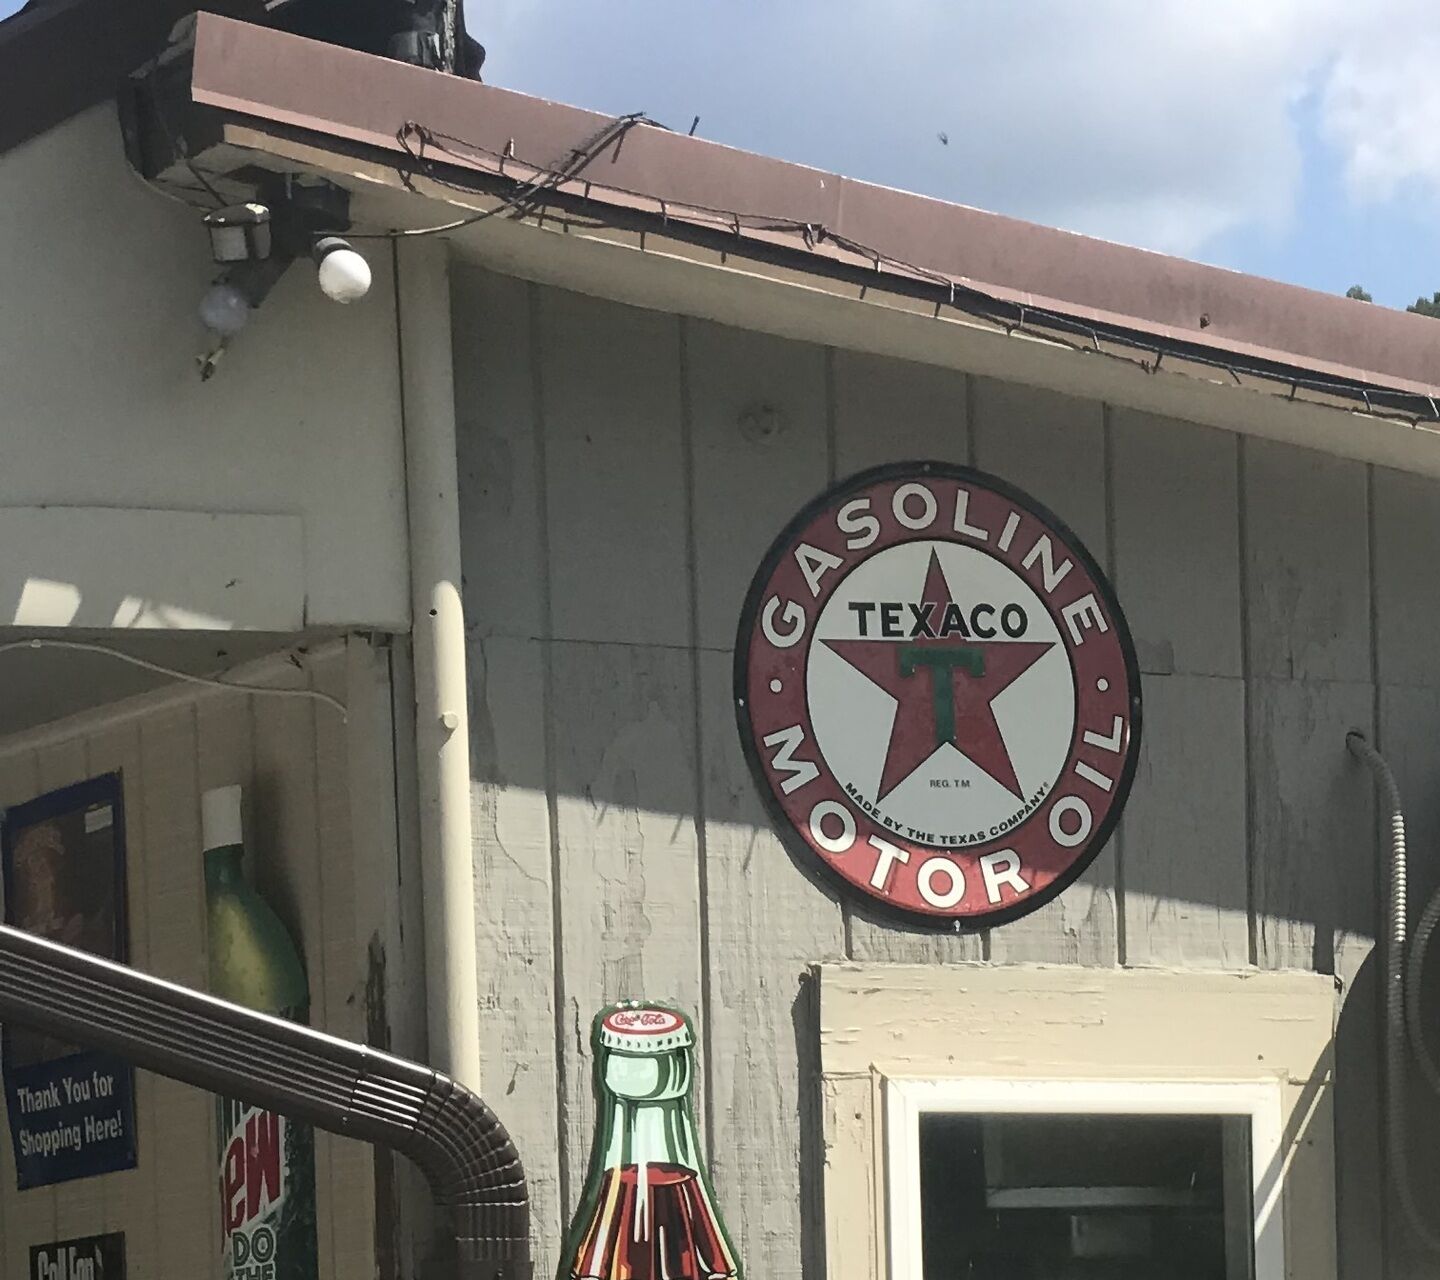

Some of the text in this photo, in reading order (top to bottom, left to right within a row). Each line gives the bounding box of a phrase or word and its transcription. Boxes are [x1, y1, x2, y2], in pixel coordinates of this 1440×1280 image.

[762, 482, 1109, 648] GASOLINE
[848, 601, 1028, 639] TEXACO
[954, 779, 971, 788] TM
[764, 715, 1125, 908] MOTOR OIL
[845, 782, 879, 819] MADE
[882, 816, 903, 831] BY
[907, 827, 935, 843] THE
[940, 831, 986, 845] TEXAS
[17, 1071, 113, 1113] Thank You for
[20, 1110, 123, 1157] Shopping Here!
[232, 1226, 274, 1267] DO
